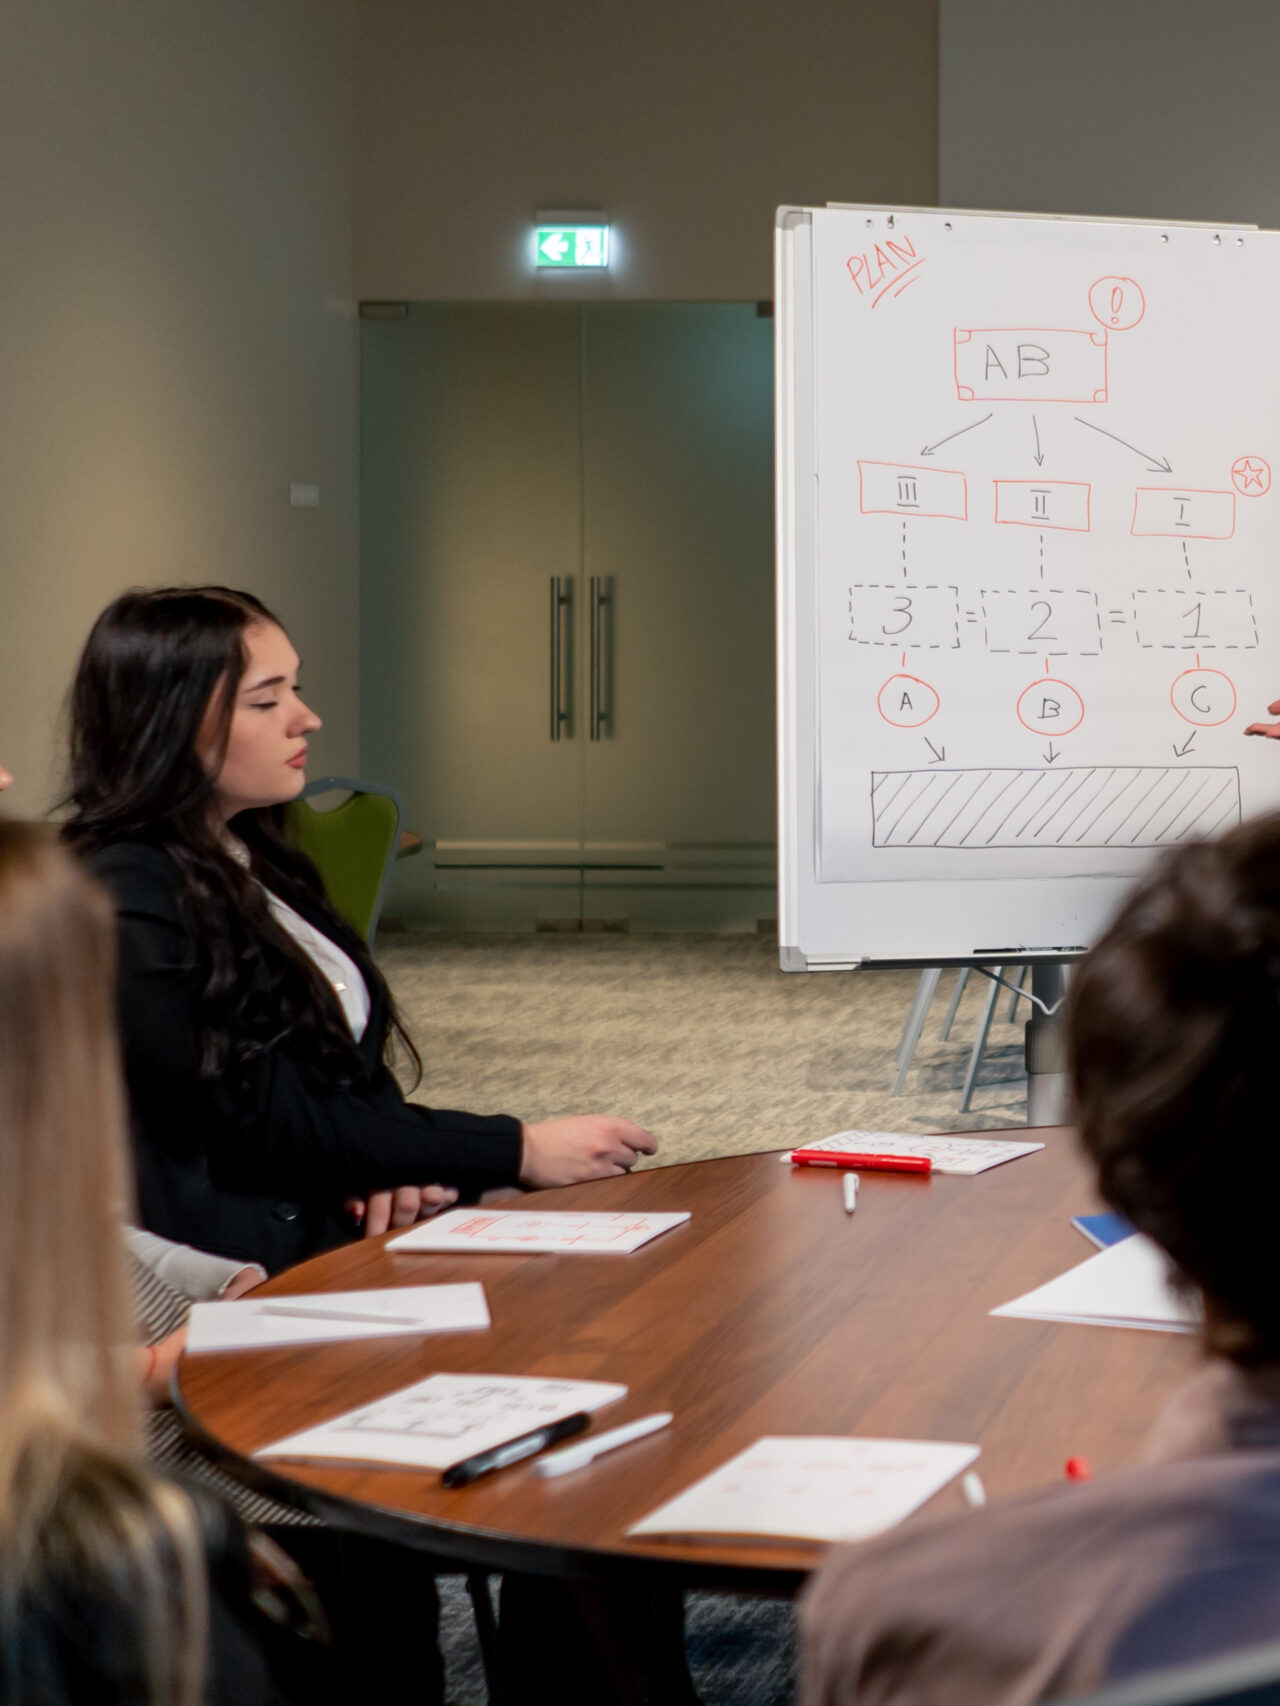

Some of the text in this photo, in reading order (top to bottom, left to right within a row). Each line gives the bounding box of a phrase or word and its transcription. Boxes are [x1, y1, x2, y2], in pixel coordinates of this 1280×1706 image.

[846, 235, 918, 294] PLAN
[985, 344, 1051, 381] AB
[896, 475, 920, 508] III
[1029, 489, 1052, 521] II
[1172, 497, 1192, 527] I
[882, 596, 913, 635] 3
[1027, 600, 1058, 641] 2
[1181, 601, 1211, 639] 1
[899, 691, 914, 712] A
[1036, 697, 1062, 719] B
[1190, 685, 1211, 714] C
